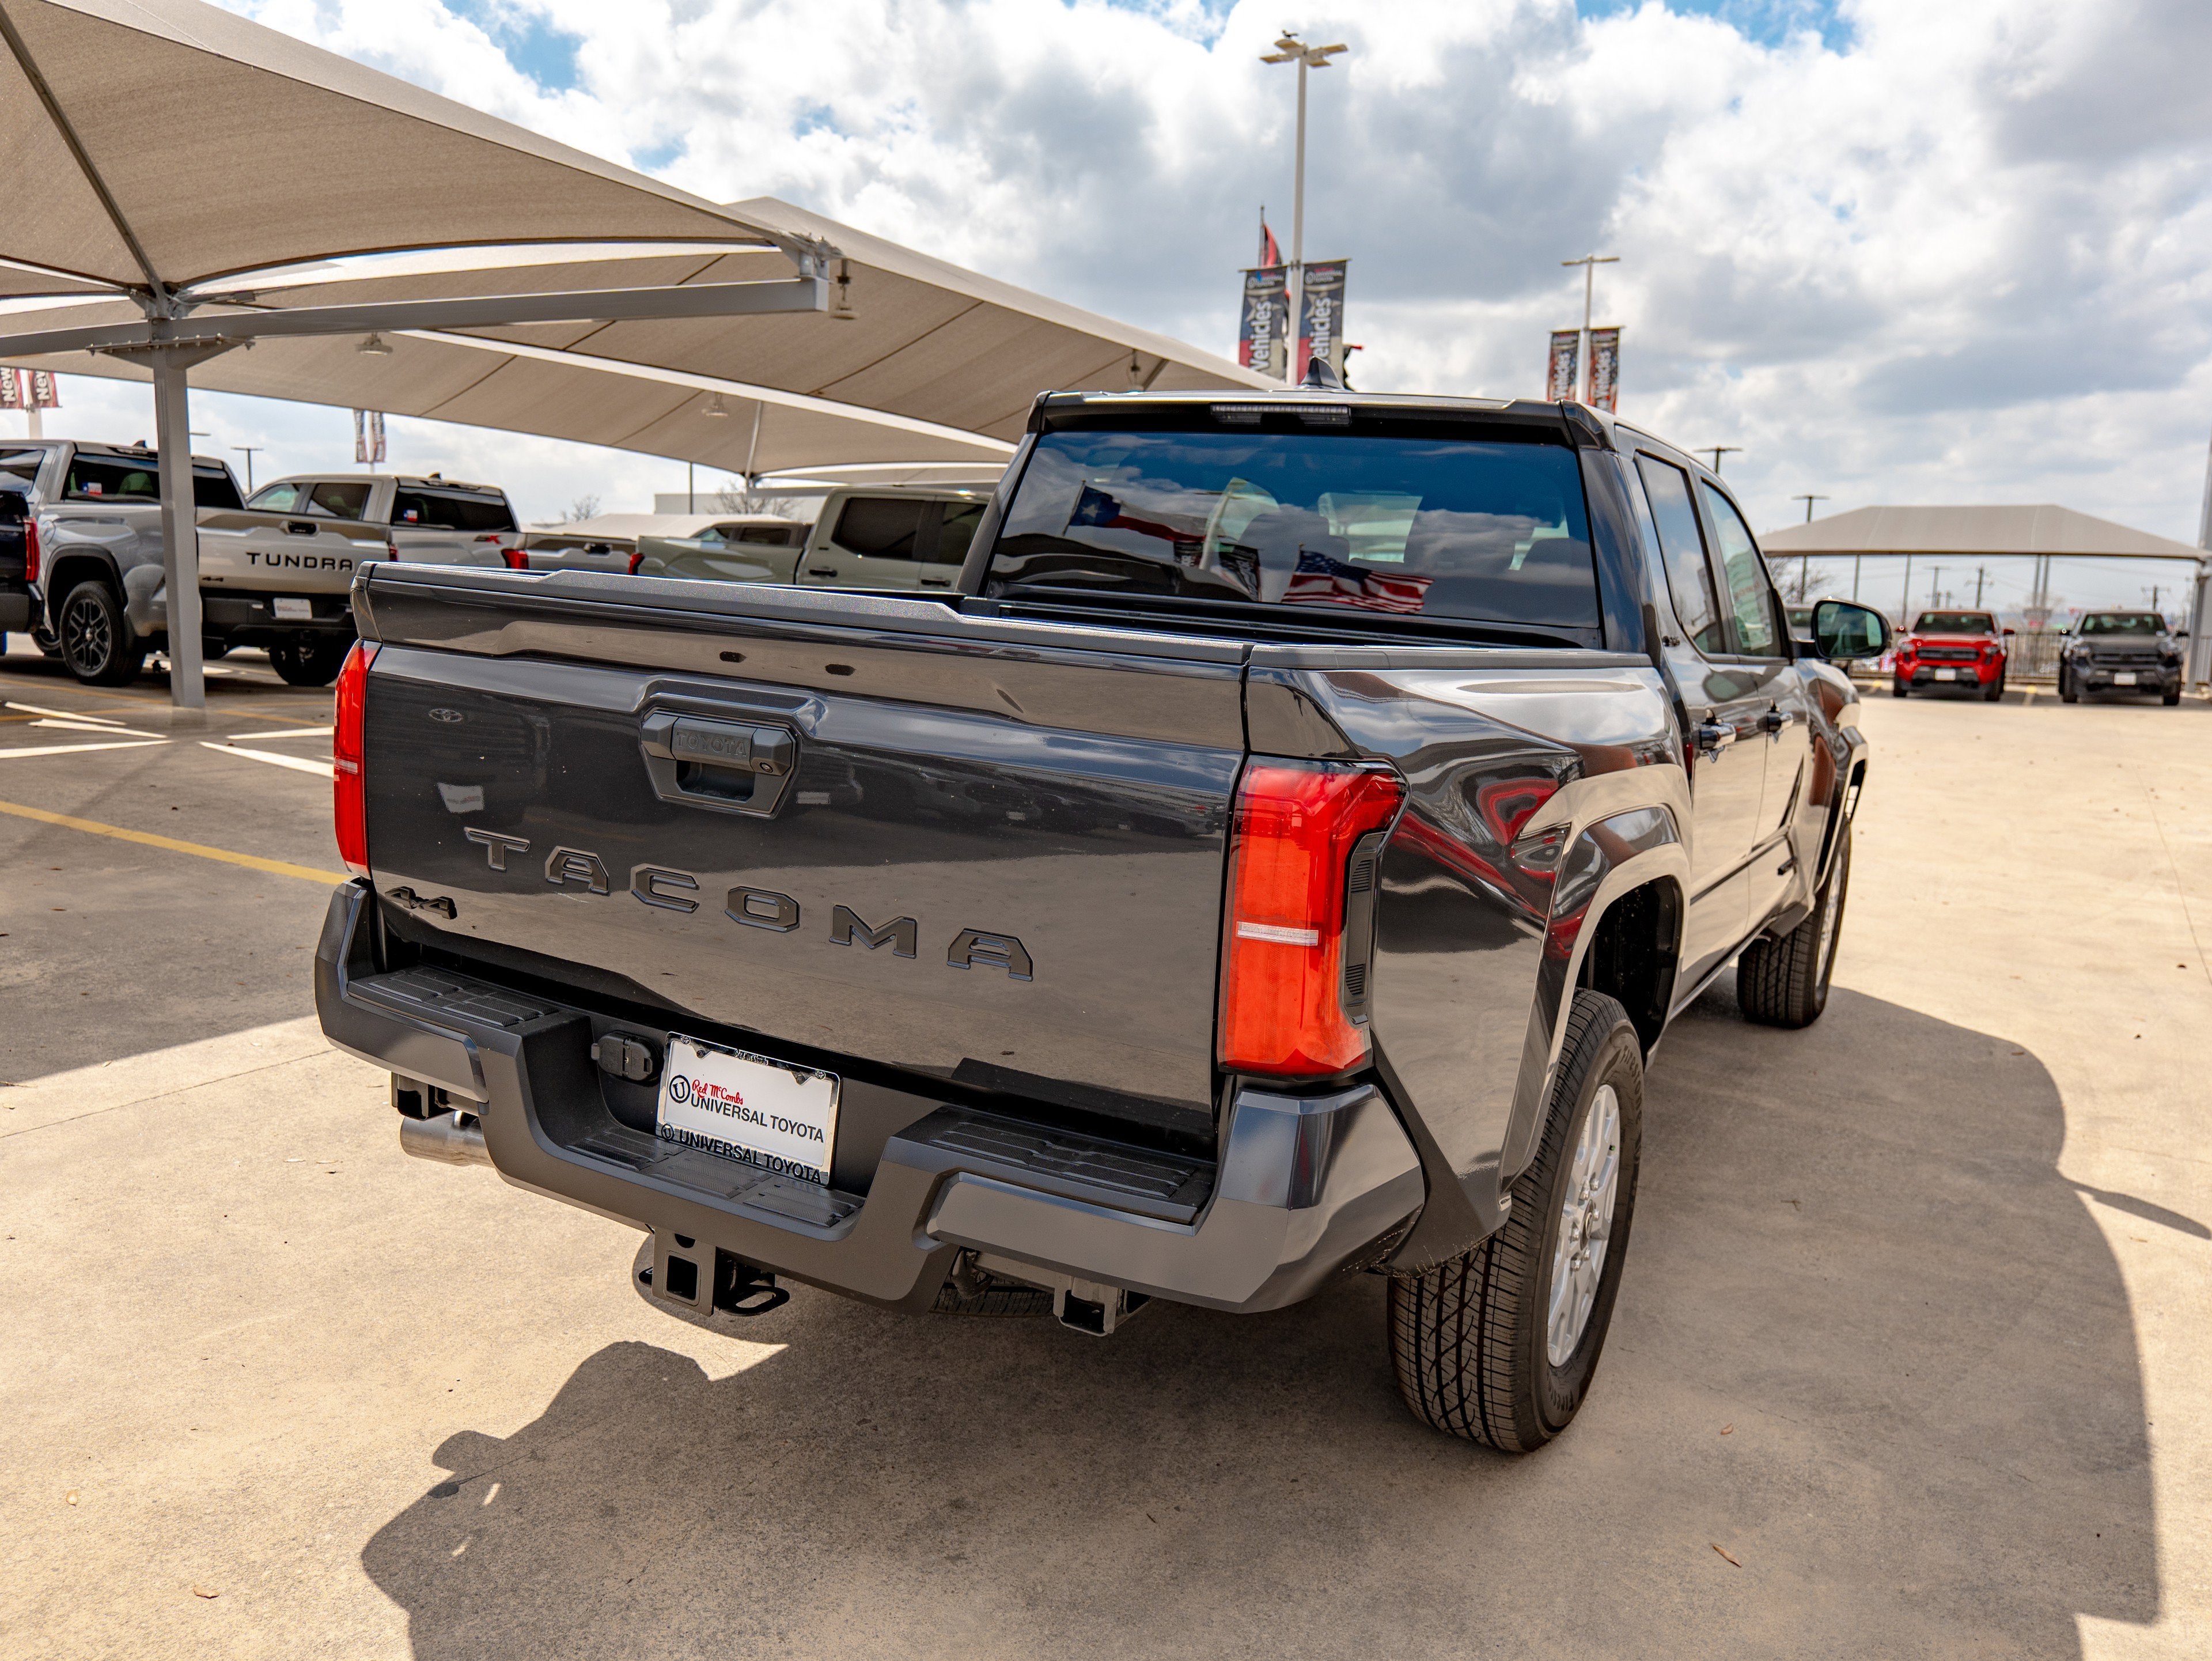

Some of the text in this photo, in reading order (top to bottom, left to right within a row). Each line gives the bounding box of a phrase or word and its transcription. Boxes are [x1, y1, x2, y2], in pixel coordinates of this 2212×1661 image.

[1249, 300, 1272, 370] Vehicles
[1308, 297, 1332, 360] ehicles
[246, 552, 353, 571] TUNDRA
[676, 732, 747, 757] TOYOTA
[464, 826, 1033, 982] TACOMA
[692, 1079, 744, 1105] Red McCombs
[1620, 1045, 1642, 1124] Firestone
[691, 1093, 824, 1143] UNIVERSAL TOYOTA
[679, 1129, 822, 1185] UNIVERSAL TOYOTA
